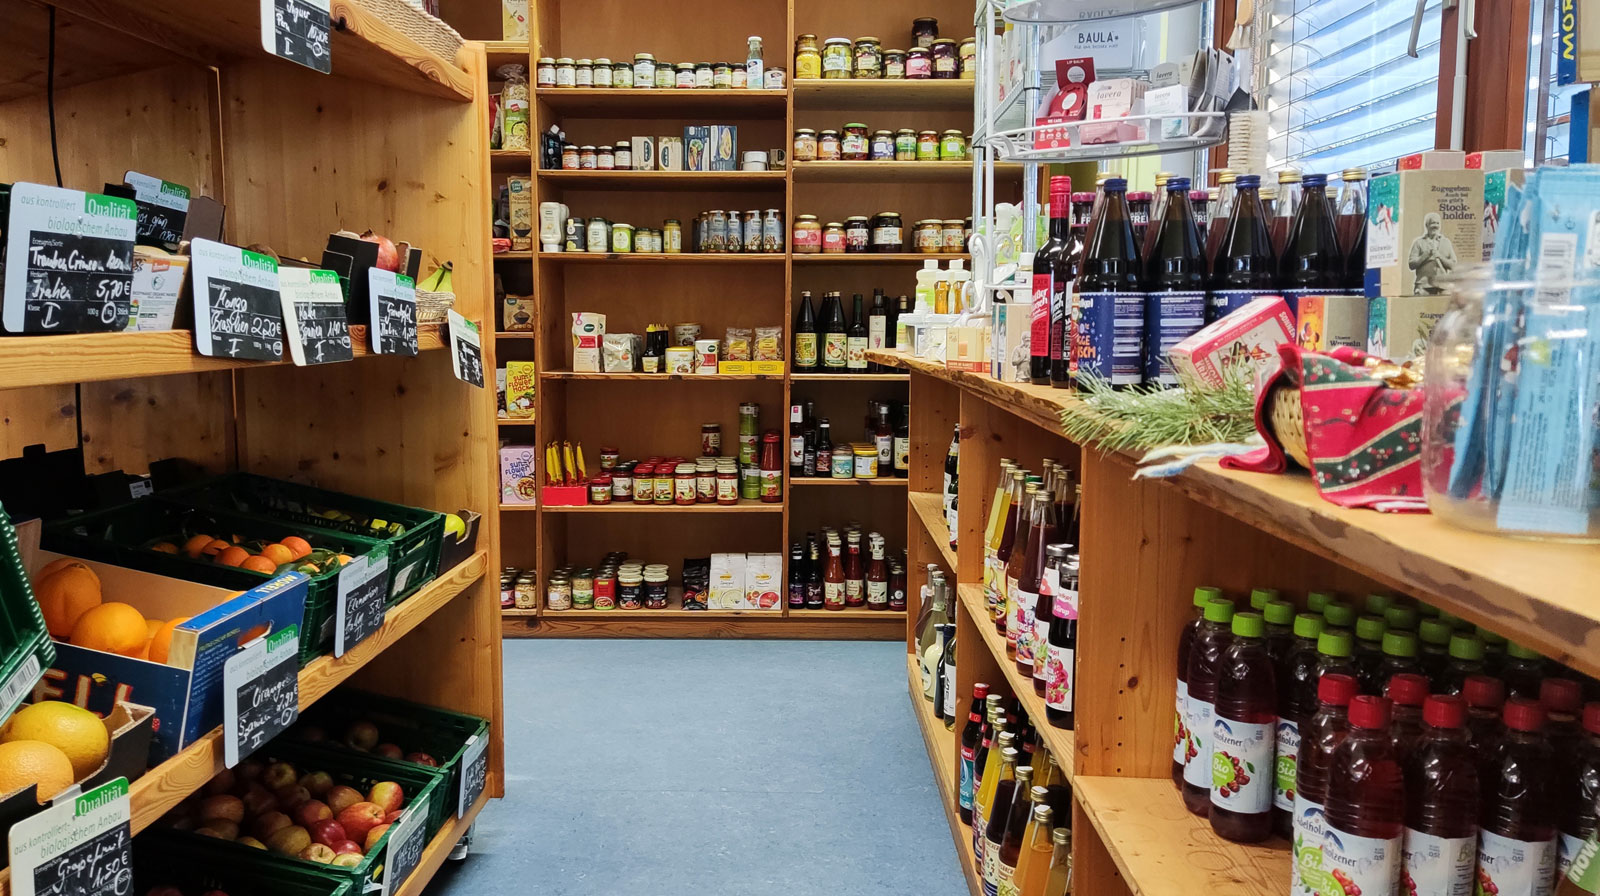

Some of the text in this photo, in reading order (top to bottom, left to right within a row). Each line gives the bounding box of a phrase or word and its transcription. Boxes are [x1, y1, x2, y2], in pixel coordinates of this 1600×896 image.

[1078, 31, 1114, 44] BAULA
[1156, 70, 1173, 79] lavera
[1097, 91, 1122, 100] lavera
[162, 183, 188, 198] Qualität
[1431, 185, 1472, 193] Zugegeben:
[20, 195, 34, 205] aus
[1439, 203, 1471, 212] Stock-
[88, 198, 131, 220] Qualität
[1442, 211, 1477, 221] holder.
[48, 215, 102, 235] biologischem
[104, 225, 128, 237] Anbau
[1130, 214, 1149, 224] FREI
[244, 254, 274, 273] Qualität
[311, 273, 337, 284] Qualität
[124, 280, 131, 296] €
[268, 630, 295, 654] Qualität
[1213, 757, 1229, 773] Bio
[1277, 760, 1296, 776] Bio
[79, 785, 123, 817] Qualität
[40, 822, 96, 859] biologischem
[98, 810, 122, 827] Anbau
[14, 843, 27, 856] aus
[52, 830, 125, 893] Grapefruit
[121, 850, 128, 865] €
[1569, 840, 1600, 883] now
